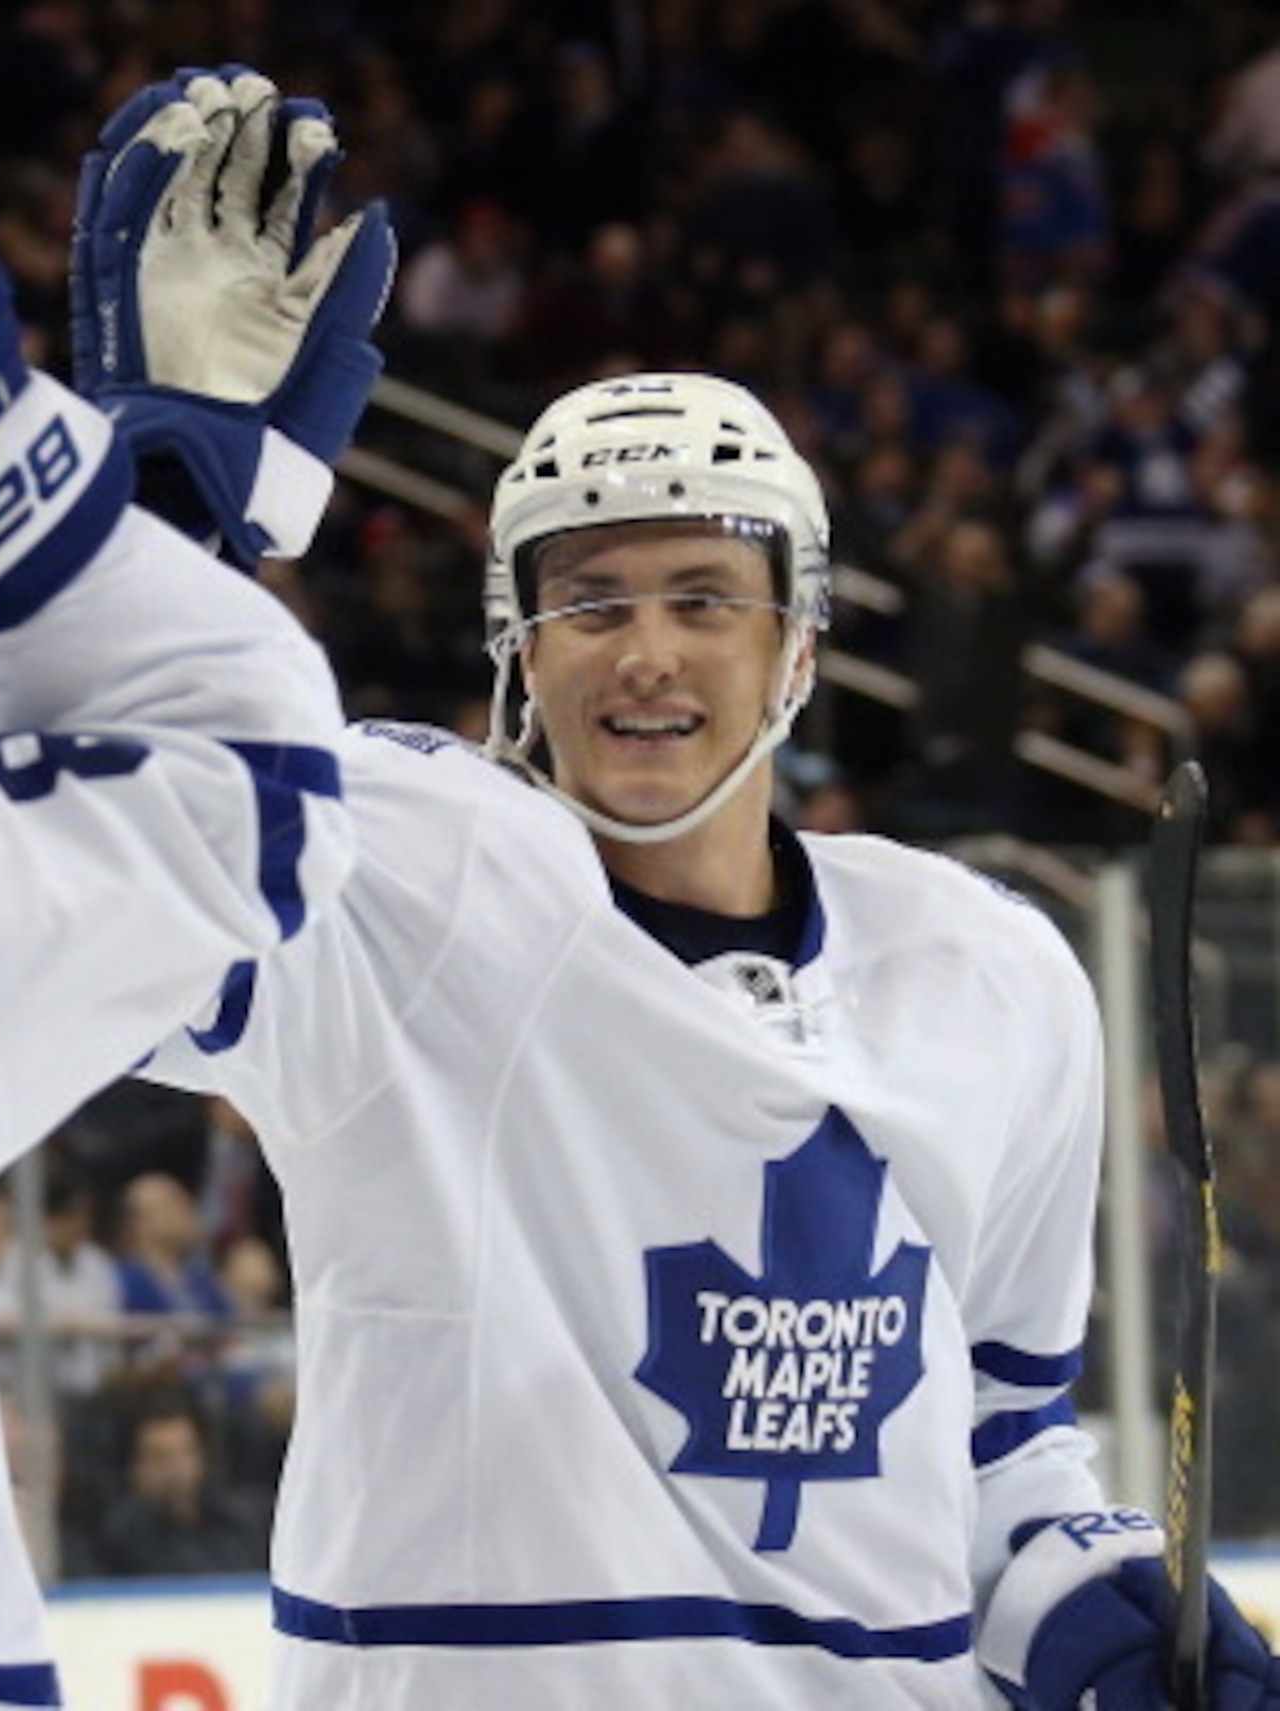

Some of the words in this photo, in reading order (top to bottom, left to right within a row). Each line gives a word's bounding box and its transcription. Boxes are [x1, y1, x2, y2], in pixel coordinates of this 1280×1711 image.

[697, 1290, 907, 1349] TORONTO
[723, 1346, 872, 1401] MAPLE
[727, 1399, 858, 1453] LEAFS
